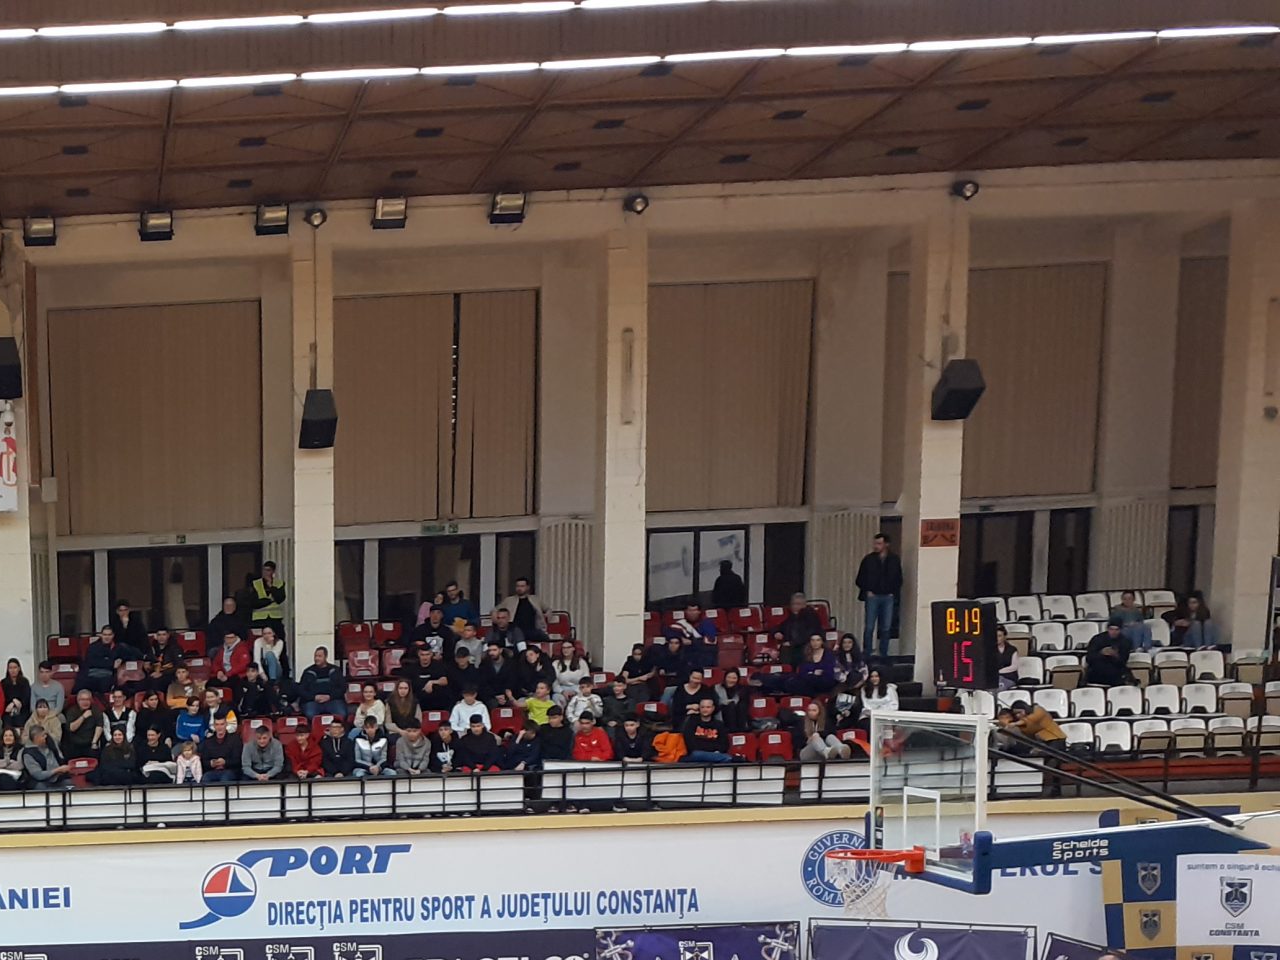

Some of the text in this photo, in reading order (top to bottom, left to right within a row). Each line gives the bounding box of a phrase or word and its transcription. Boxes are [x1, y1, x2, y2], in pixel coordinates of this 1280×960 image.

[946, 607, 981, 635] 8:19
[953, 641, 974, 682] 15
[1052, 839, 1109, 850] Schelde
[1052, 848, 1109, 860] Sports
[349, 897, 415, 923] PENTRU
[421, 894, 475, 921] SPORT
[480, 894, 493, 919] A
[195, 946, 219, 956] CSM
[265, 944, 290, 954] CSM
[333, 942, 357, 952] CSM
[0, 951, 23, 960] CSM
